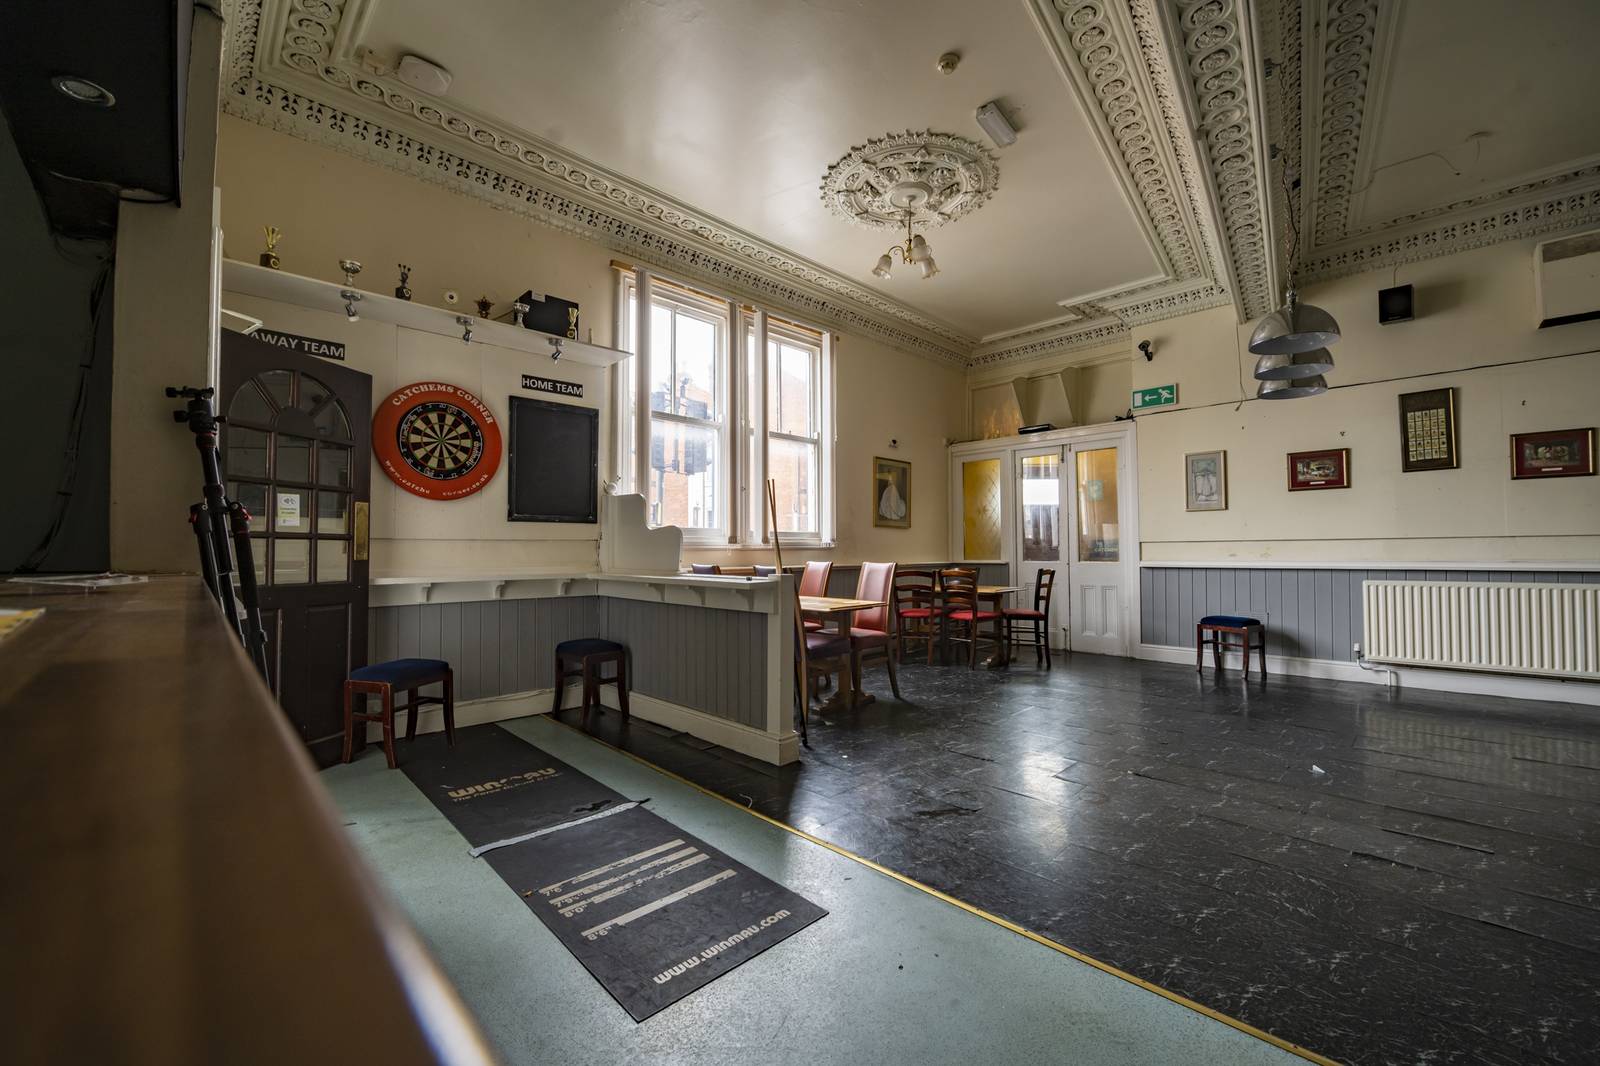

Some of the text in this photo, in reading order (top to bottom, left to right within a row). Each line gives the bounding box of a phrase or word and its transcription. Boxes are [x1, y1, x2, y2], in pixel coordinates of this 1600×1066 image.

[250, 331, 345, 358] AWAY TEAM
[522, 377, 583, 396] HOME TEAM
[392, 384, 493, 424] CATCHEMS CORNER
